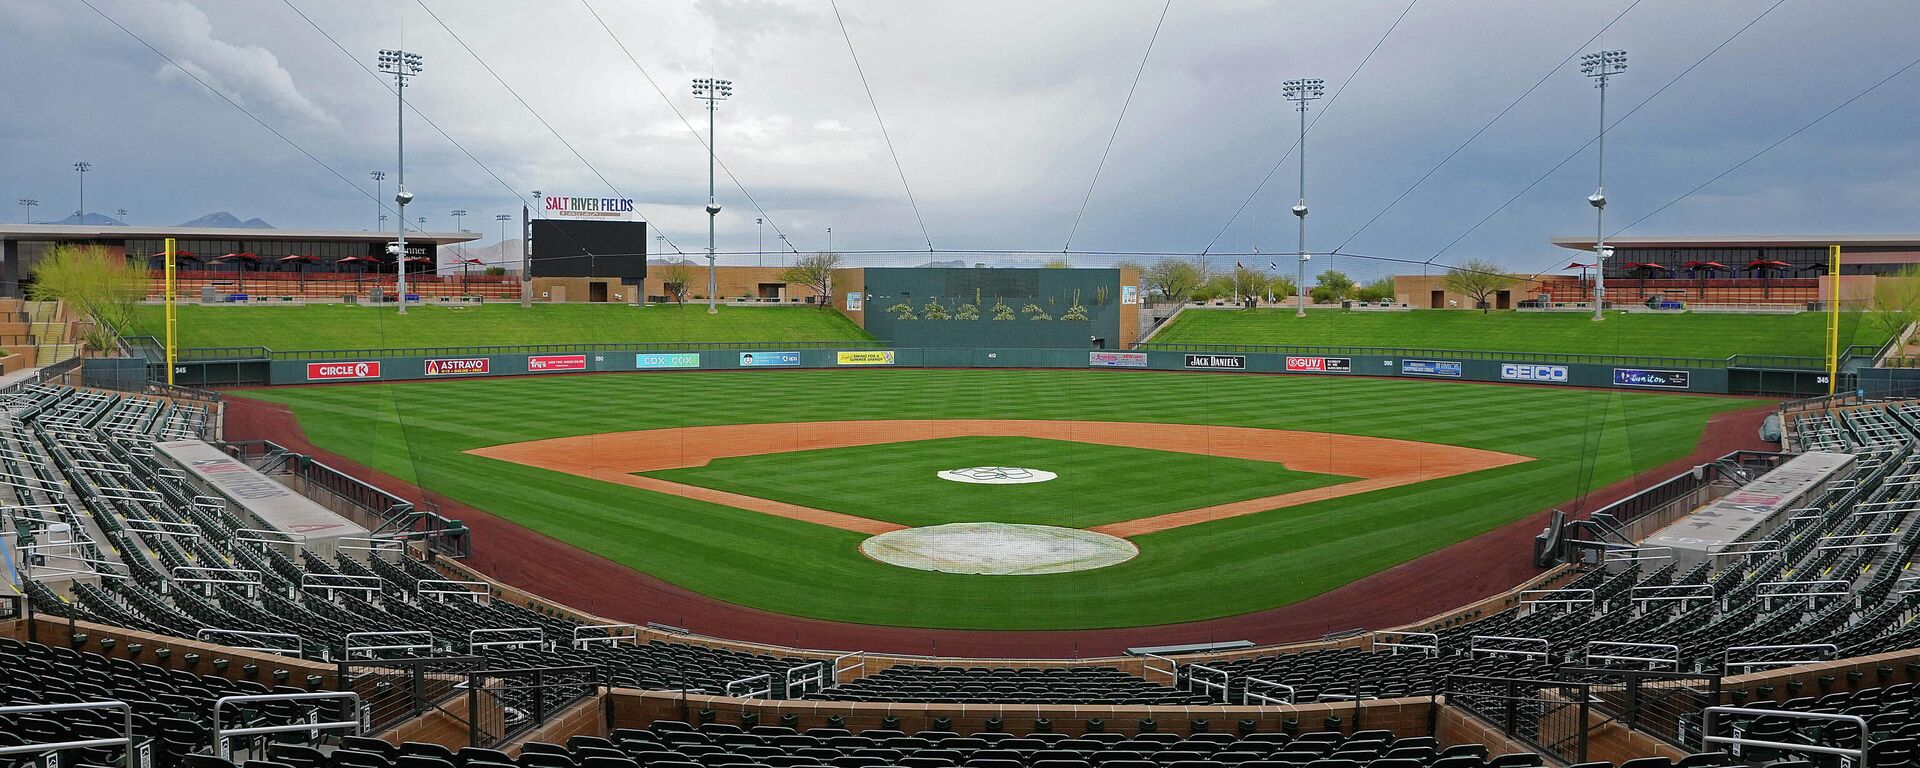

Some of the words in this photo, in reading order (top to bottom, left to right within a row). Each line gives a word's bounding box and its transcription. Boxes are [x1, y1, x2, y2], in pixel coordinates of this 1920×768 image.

[545, 196, 569, 210] SALT
[571, 197, 599, 211] RIVER
[601, 198, 633, 212] FIELDS
[441, 360, 483, 369] ASTRAVO
[644, 357, 665, 365] COX
[1190, 356, 1209, 366] JACK
[1210, 356, 1239, 367] DANIEL'S
[319, 366, 354, 376] CIRCLE
[356, 364, 368, 376] K
[1502, 365, 1567, 380] GEICO
[1816, 376, 1829, 384] 345
